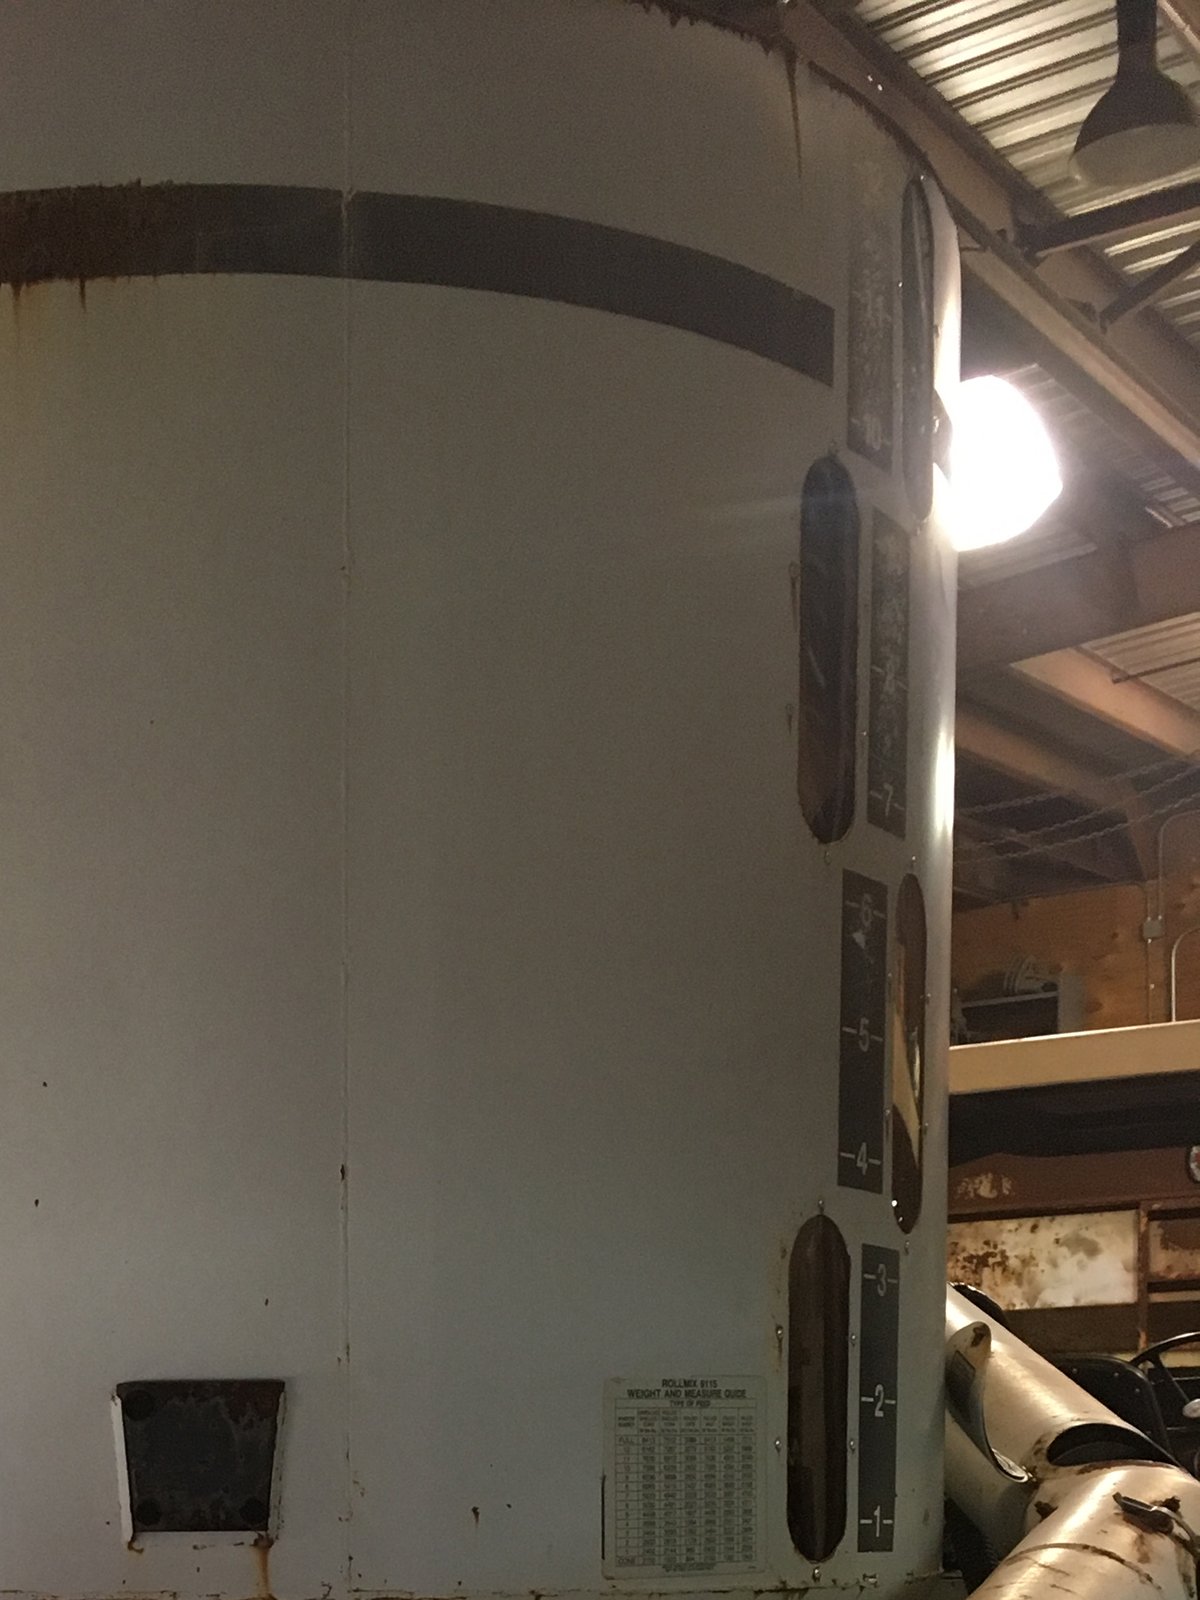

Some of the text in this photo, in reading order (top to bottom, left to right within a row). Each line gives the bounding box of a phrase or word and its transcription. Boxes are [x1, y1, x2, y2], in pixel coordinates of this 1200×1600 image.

[883, 783, 894, 817] 7
[861, 893, 872, 928] 6
[858, 1017, 870, 1052] 5
[856, 1142, 868, 1175] 4
[877, 1263, 887, 1296] 3
[627, 1389, 660, 1398] WEIGHT
[664, 1389, 681, 1398] AND
[684, 1389, 722, 1398] MEASURE
[662, 1379, 697, 1388] ROLLMIX
[875, 1384, 884, 1417] 2
[874, 1505, 880, 1537] 1
